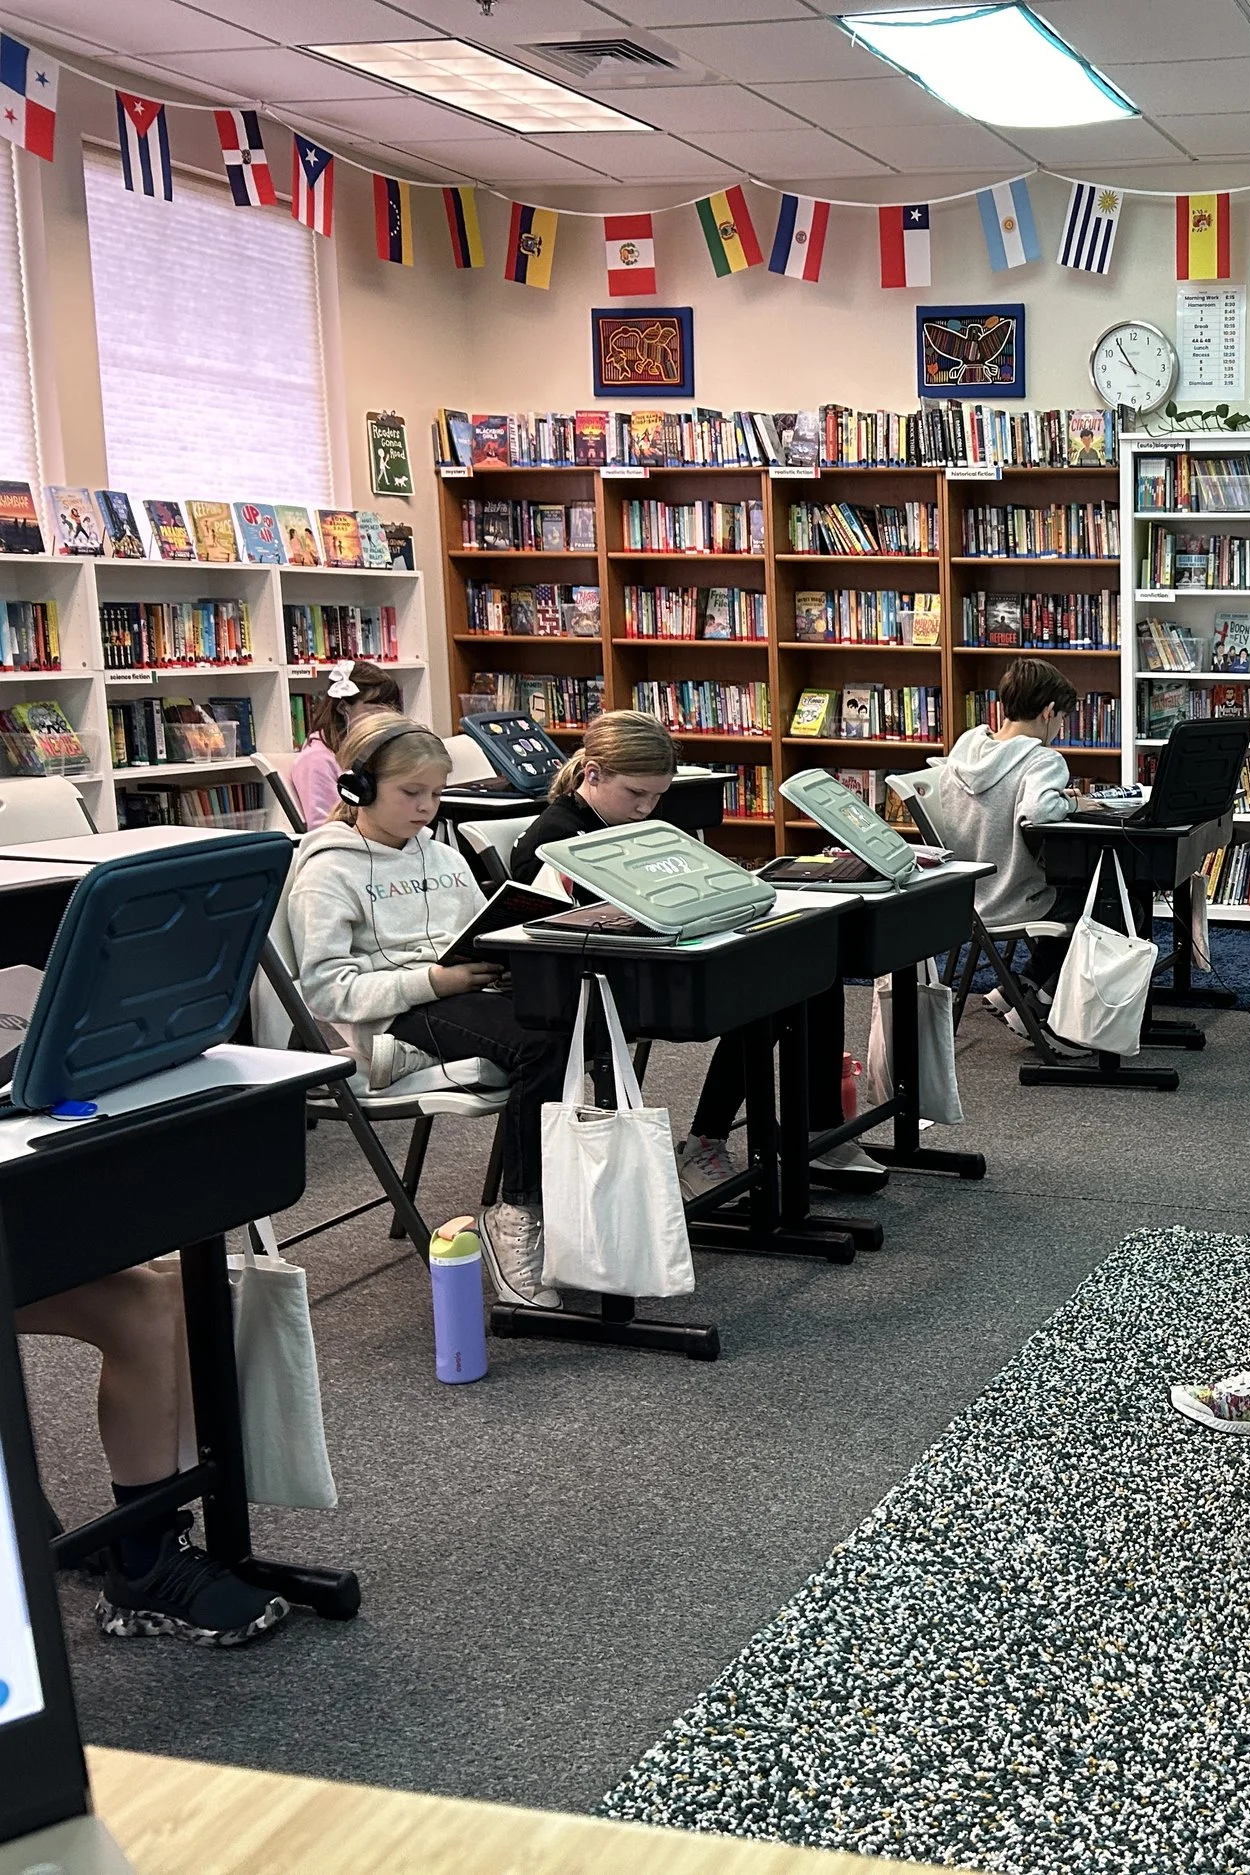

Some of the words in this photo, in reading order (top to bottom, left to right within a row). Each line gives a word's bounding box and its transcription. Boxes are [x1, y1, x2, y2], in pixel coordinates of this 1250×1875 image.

[1129, 332, 1138, 341] 12
[1104, 349, 1114, 358] 10
[1156, 348, 1162, 357] 2
[1101, 364, 1107, 373] 9
[1160, 364, 1166, 373] 3
[1106, 380, 1112, 389] 8
[1155, 379, 1161, 387] 4
[1116, 392, 1122, 401] 7
[1131, 395, 1137, 404] 6
[1146, 391, 1151, 400] 5
[1071, 418, 1103, 432] CIRCUIT
[242, 505, 261, 526] UP
[914, 619, 939, 628] MIDDLE
[1230, 620, 1250, 635] BORN
[989, 632, 1017, 644] REFUGEE
[1234, 633, 1249, 646] FLY
[365, 872, 468, 902] SEABROOK
